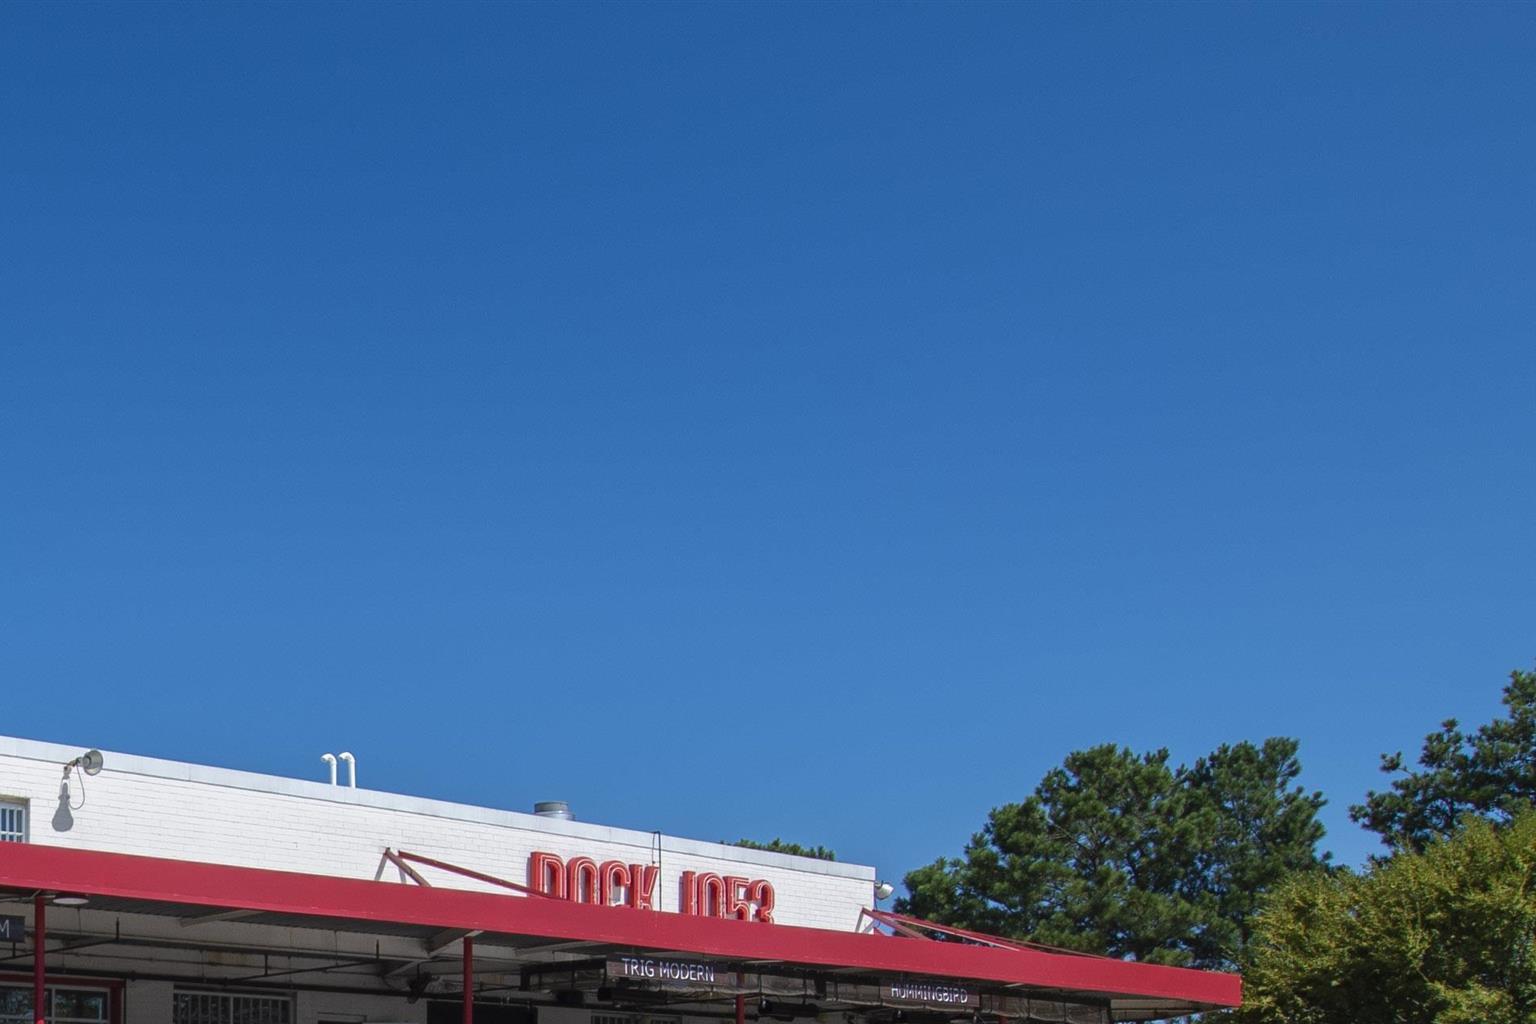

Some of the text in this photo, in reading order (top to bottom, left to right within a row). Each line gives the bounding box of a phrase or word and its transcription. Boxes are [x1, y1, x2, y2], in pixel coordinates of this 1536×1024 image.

[530, 851, 776, 924] DOCK 1053
[622, 957, 714, 982] TRIG MODERN
[891, 984, 968, 1003] HUMMINGBIRD
